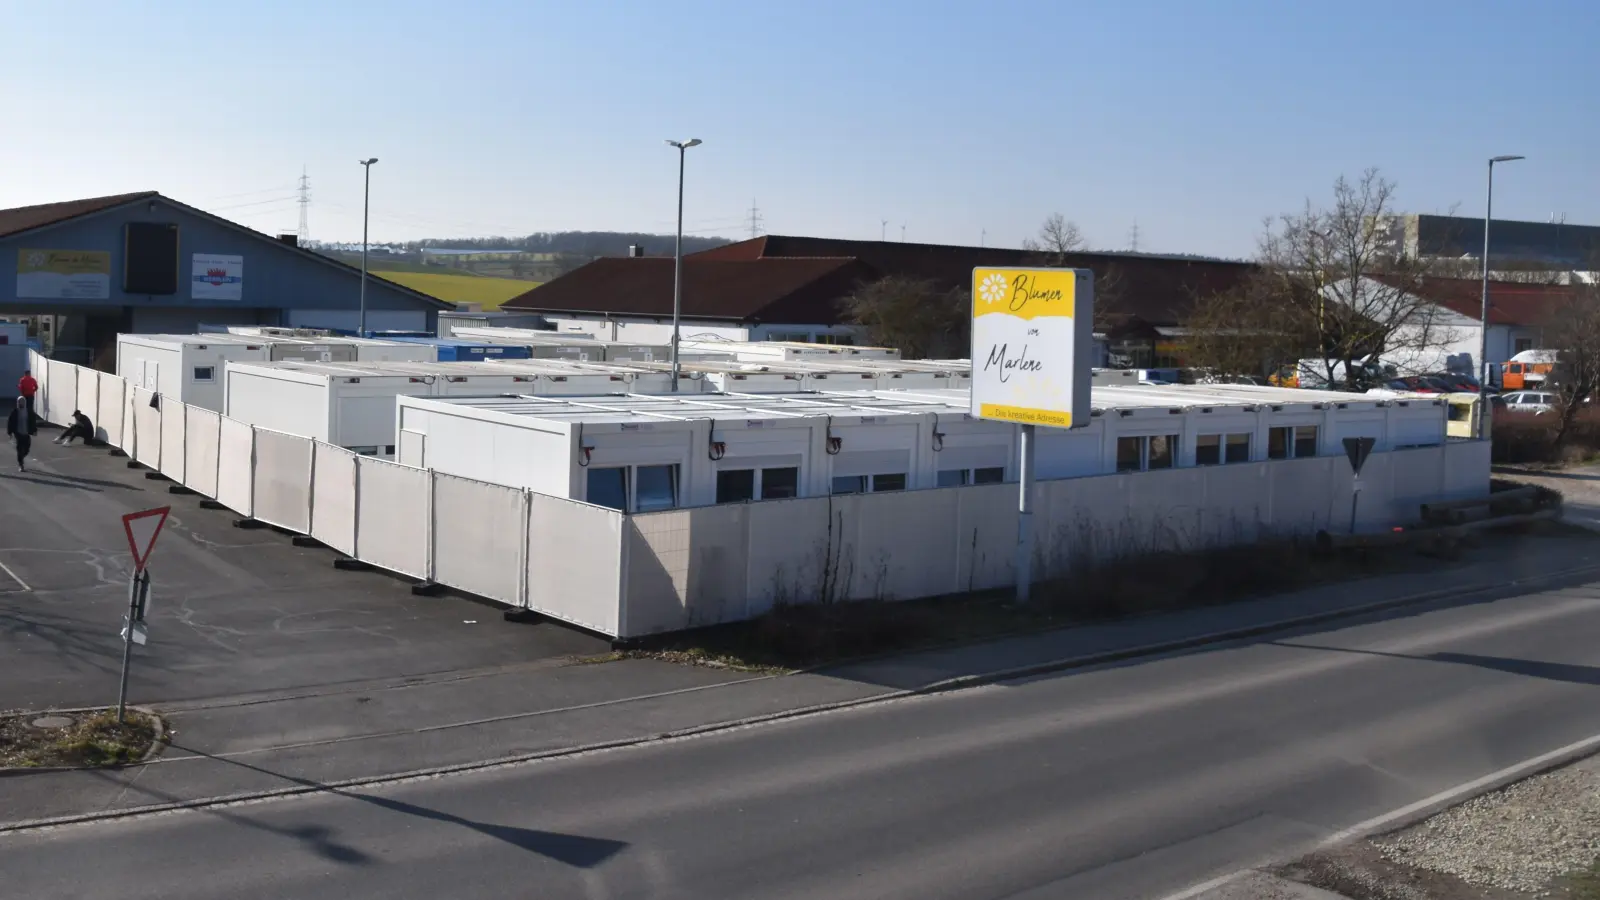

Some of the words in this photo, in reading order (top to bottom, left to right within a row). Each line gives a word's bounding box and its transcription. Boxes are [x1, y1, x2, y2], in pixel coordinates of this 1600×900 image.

[1009, 274, 1062, 311] Blumen
[1027, 328, 1040, 336] von
[984, 343, 1042, 383] Marlene
[1008, 410, 1035, 421] kreative
[1036, 413, 1065, 424] Adresse
